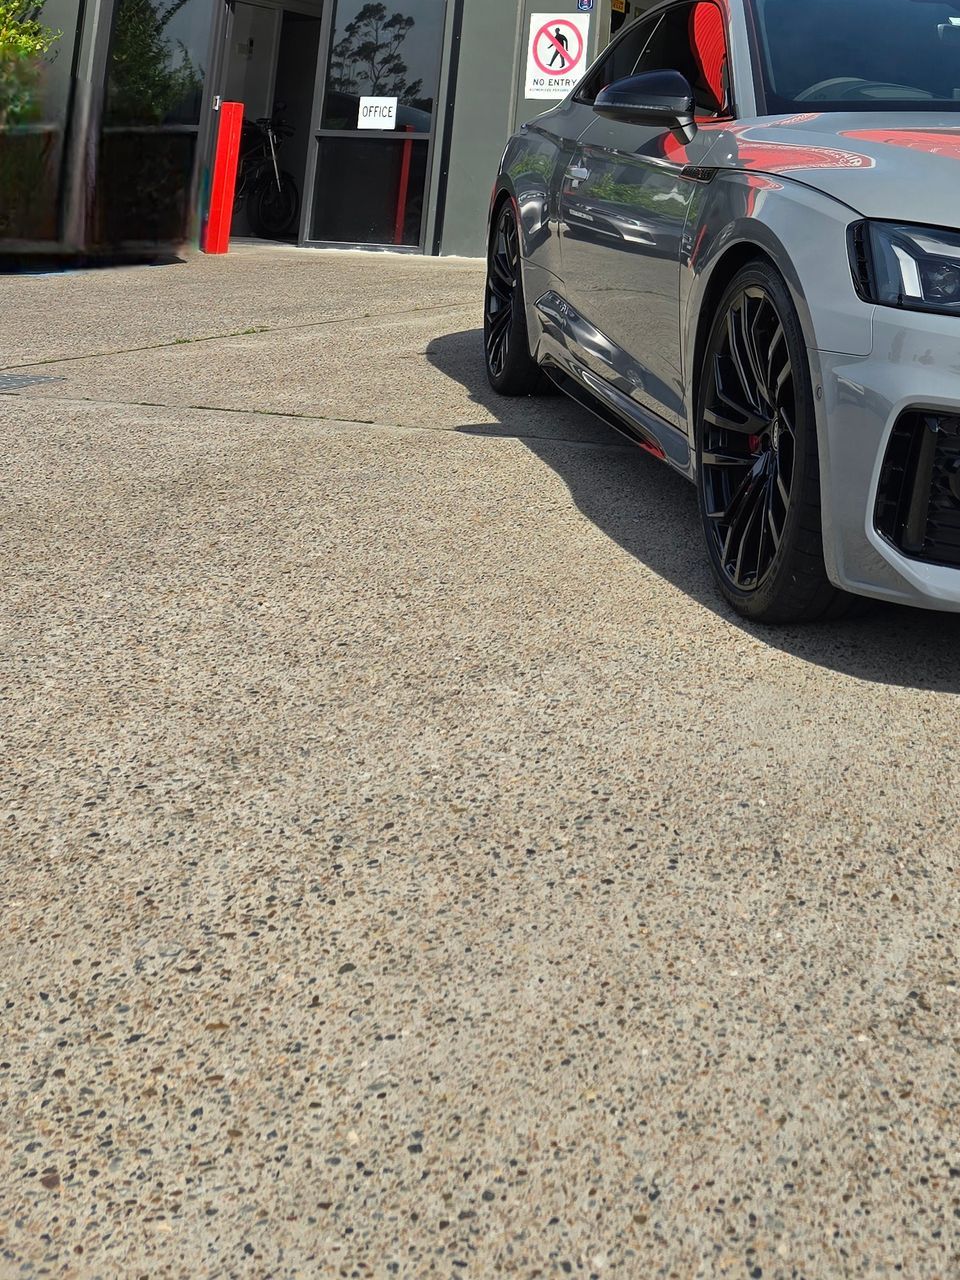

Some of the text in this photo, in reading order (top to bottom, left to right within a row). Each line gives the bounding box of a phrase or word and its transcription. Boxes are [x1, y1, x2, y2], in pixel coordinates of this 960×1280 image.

[532, 78, 578, 87] NO ENTRY
[362, 105, 394, 118] OFFICE
